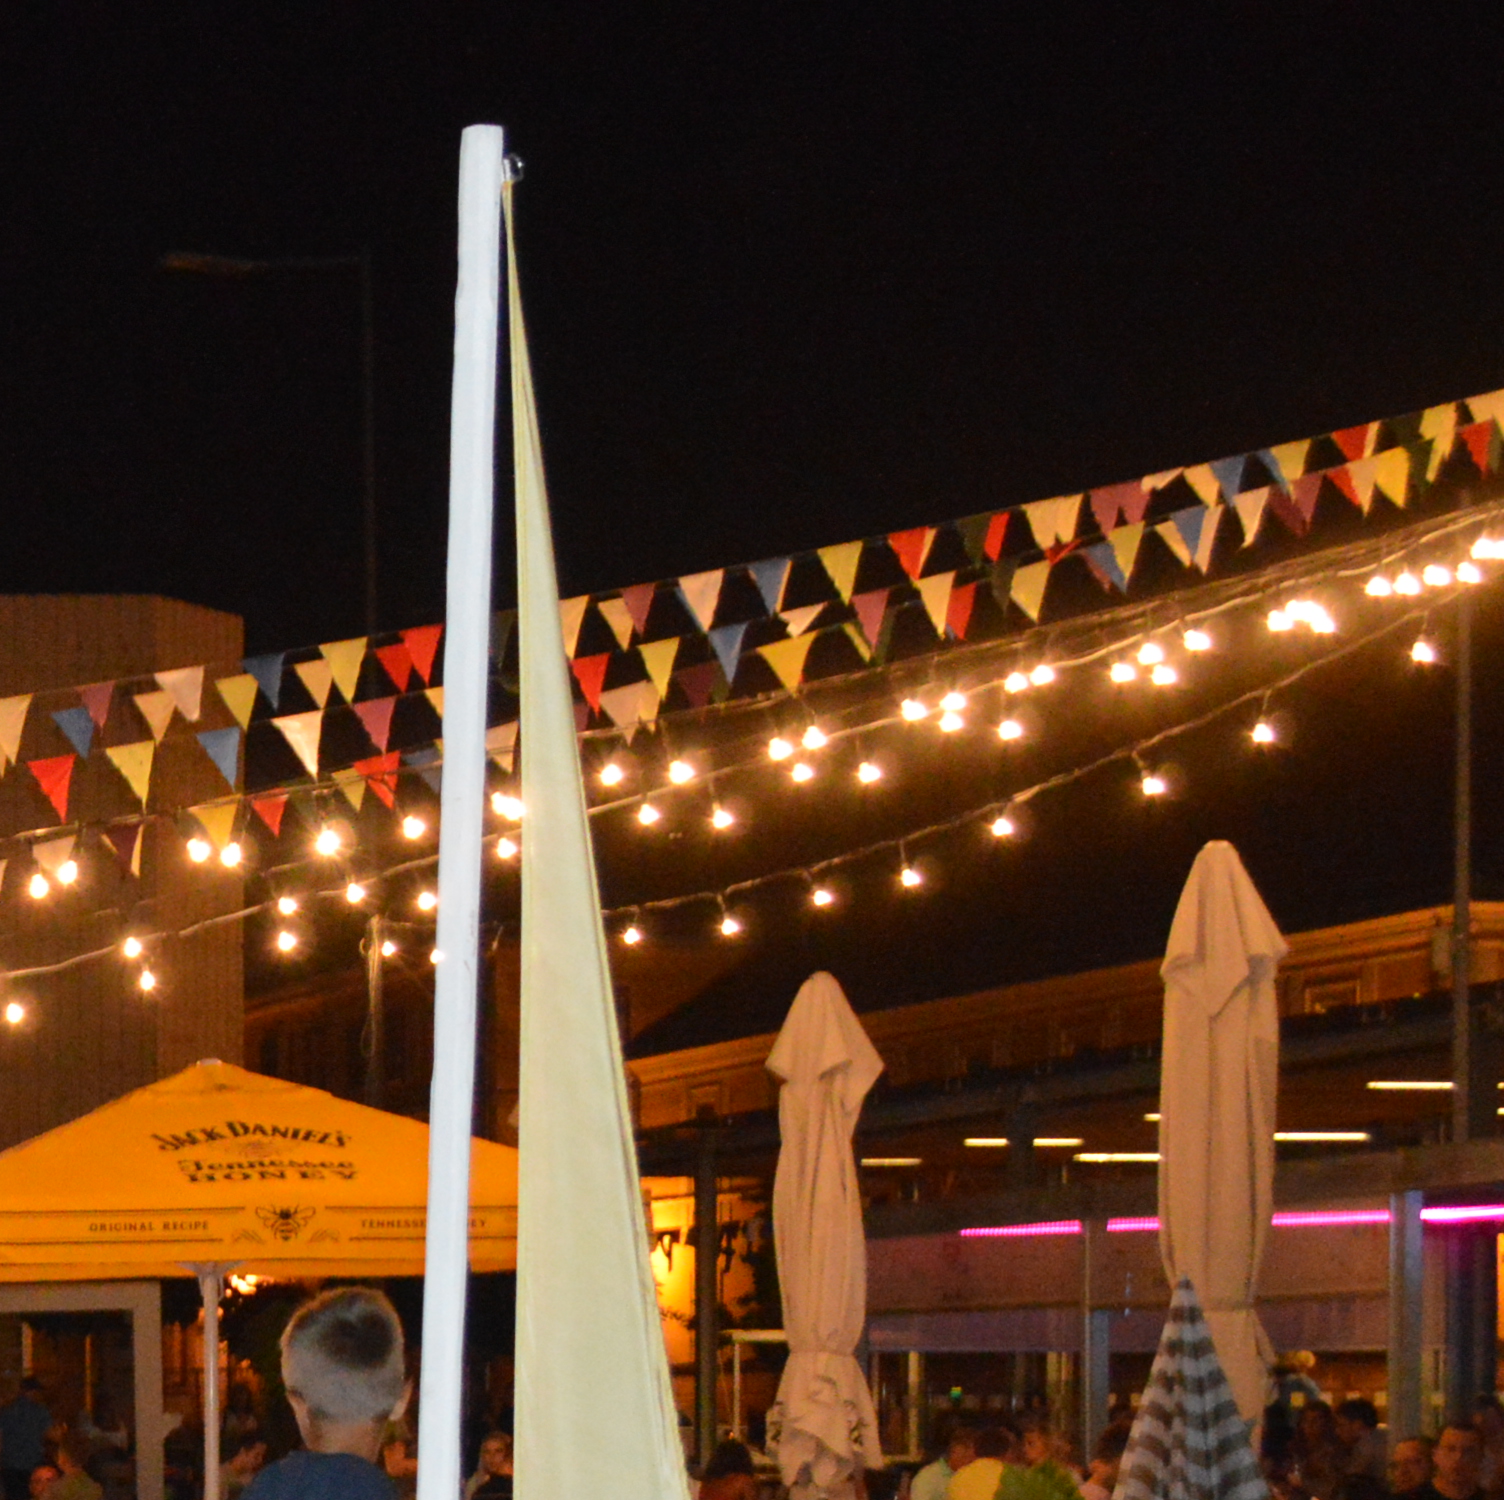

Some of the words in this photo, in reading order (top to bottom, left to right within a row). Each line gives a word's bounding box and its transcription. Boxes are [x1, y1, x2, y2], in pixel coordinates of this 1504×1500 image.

[88, 1221, 155, 1232] ORIGINAL
[162, 1219, 210, 1231] RECIPE
[361, 1217, 428, 1229] TENNESSE
